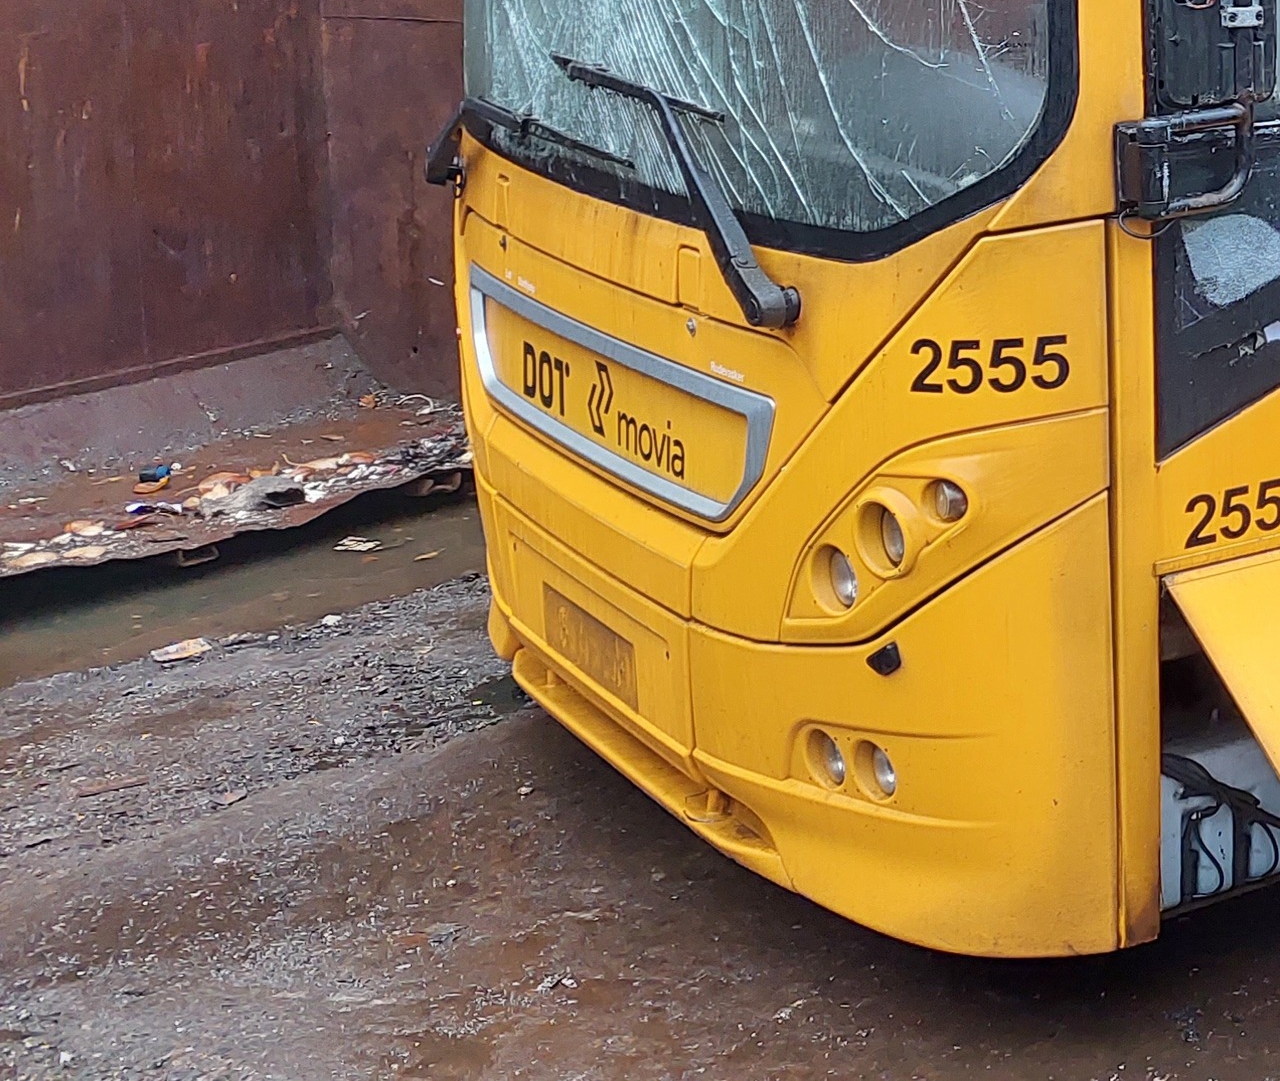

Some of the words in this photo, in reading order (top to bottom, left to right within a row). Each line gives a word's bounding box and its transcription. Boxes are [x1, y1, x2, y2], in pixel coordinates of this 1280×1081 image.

[523, 340, 570, 417] DOT
[617, 410, 685, 480] movia
[910, 335, 1070, 395] 2555
